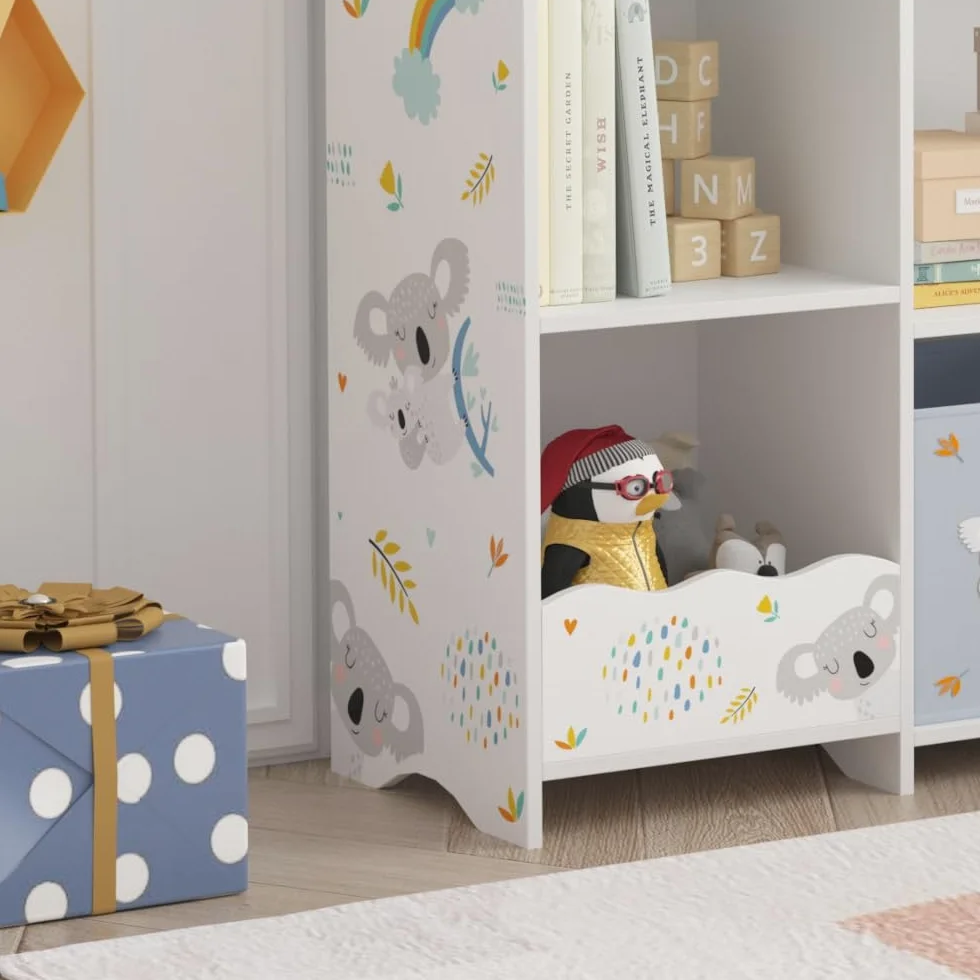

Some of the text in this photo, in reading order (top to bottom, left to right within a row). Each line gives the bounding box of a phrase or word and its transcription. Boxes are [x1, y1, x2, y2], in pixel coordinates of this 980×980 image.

[655, 56, 678, 85] D
[699, 55, 711, 86] C
[596, 117, 607, 172] WISH
[636, 56, 657, 226] THE MAGICAL ELEPHANT
[693, 174, 719, 205] N
[736, 175, 751, 206] M
[691, 235, 708, 267] 3
[750, 231, 768, 262] Z
